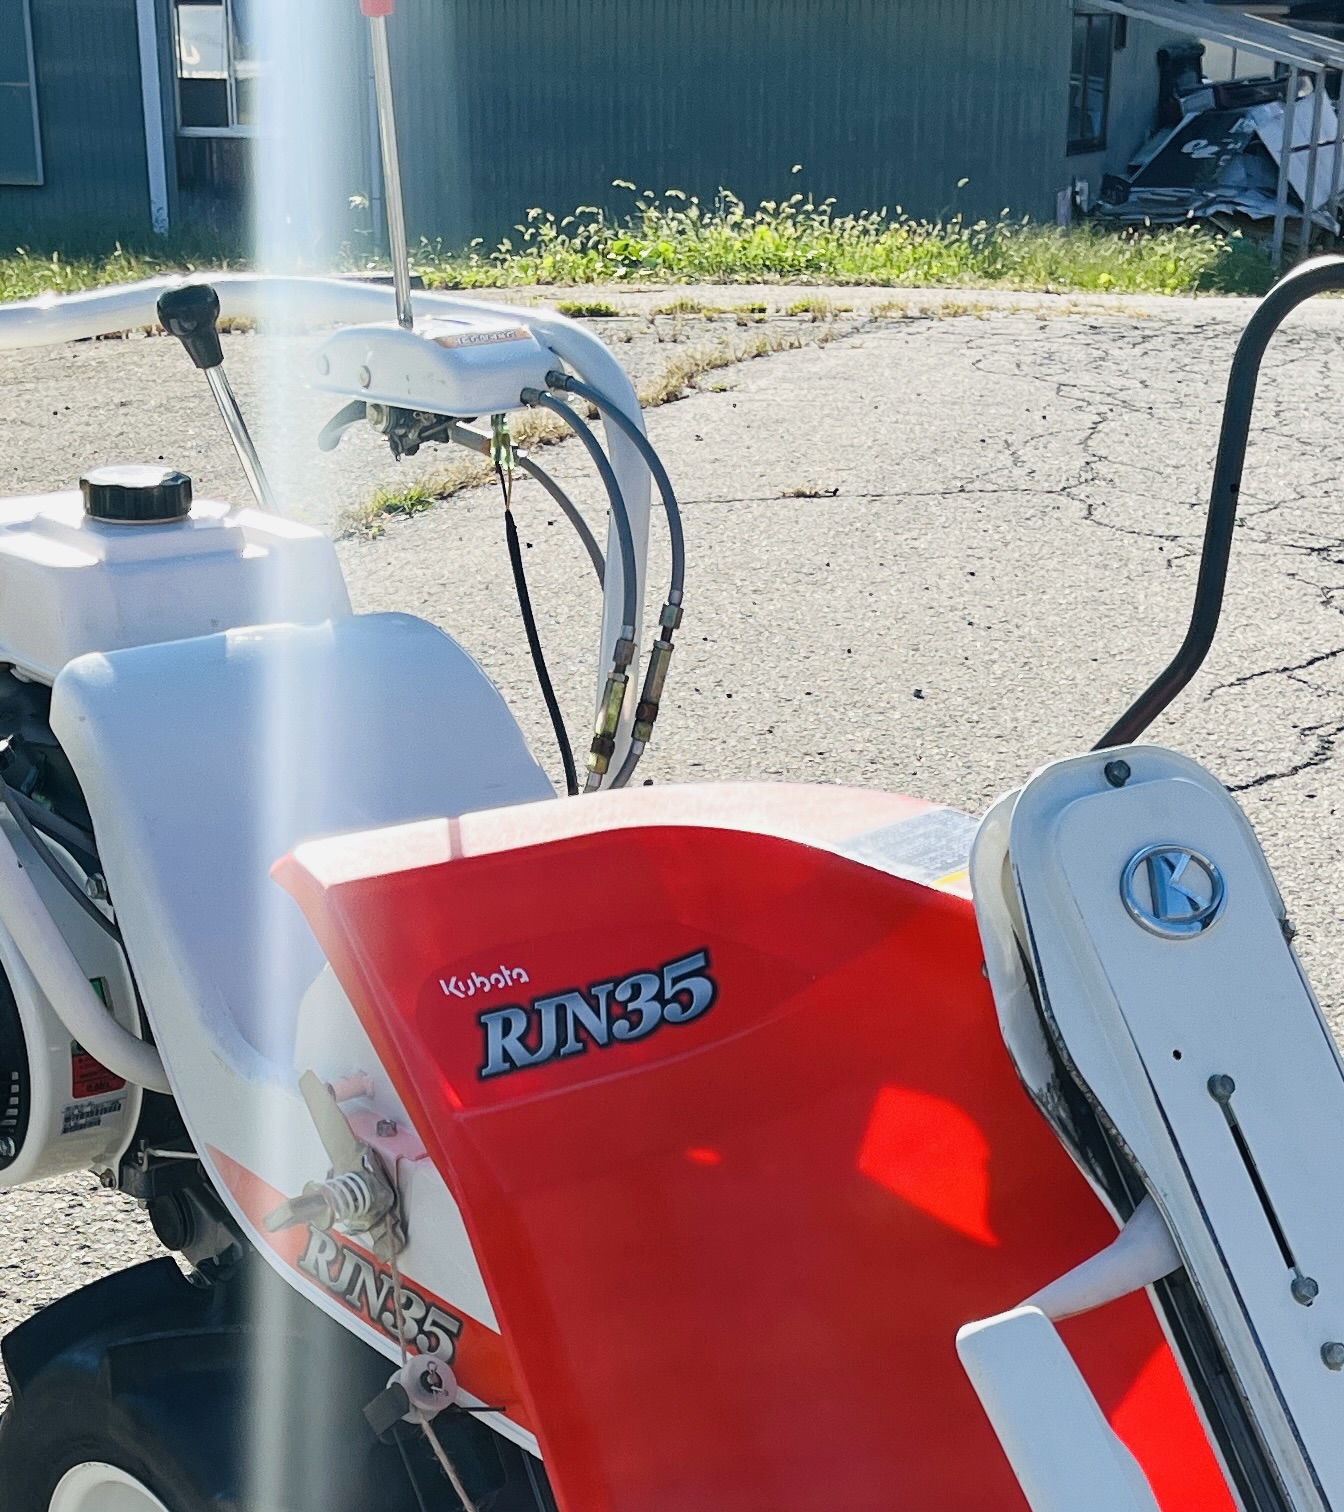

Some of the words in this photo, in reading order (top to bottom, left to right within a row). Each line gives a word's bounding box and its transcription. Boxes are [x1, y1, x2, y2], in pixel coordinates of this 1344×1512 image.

[439, 965, 530, 999] Kubota
[478, 949, 716, 1080] RJN35
[297, 1225, 463, 1365] RJN35
